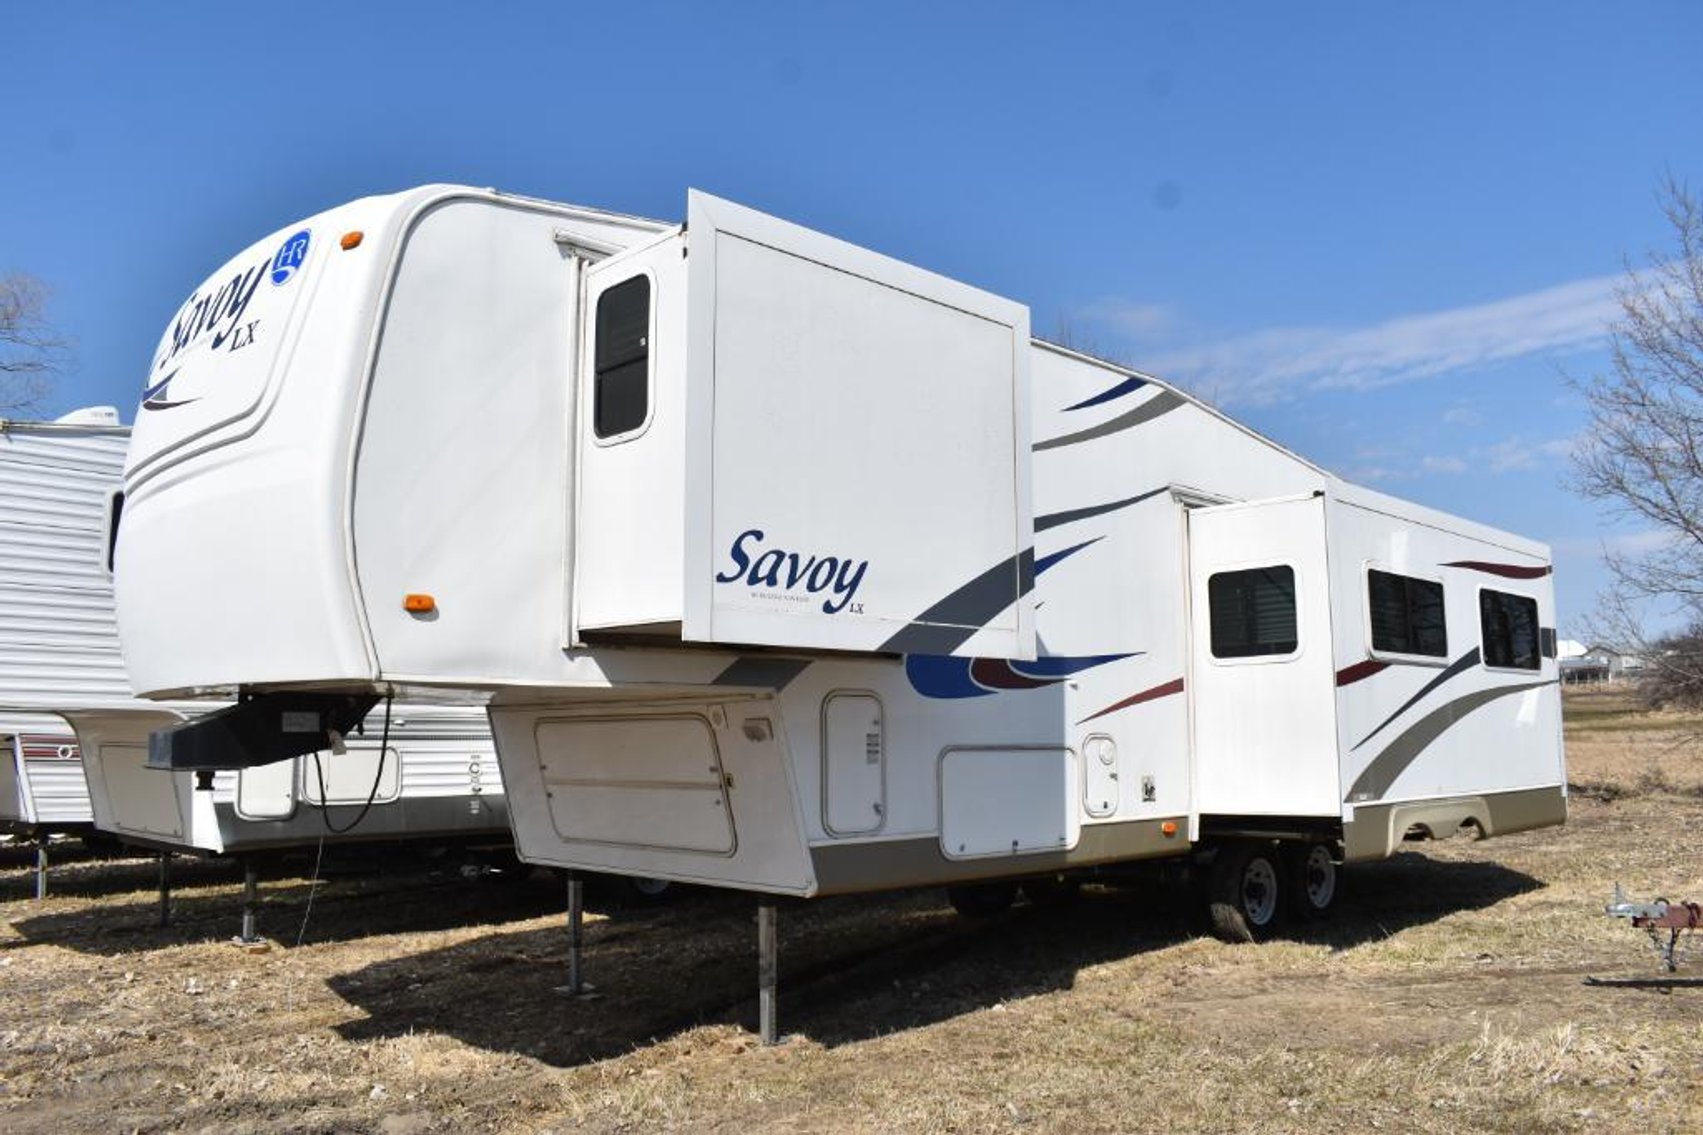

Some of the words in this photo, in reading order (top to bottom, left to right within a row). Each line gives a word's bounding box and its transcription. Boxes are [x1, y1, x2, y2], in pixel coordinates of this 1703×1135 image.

[278, 239, 307, 267] HR
[160, 257, 272, 370] Savoy
[229, 319, 261, 352] LX
[716, 529, 869, 615] Savoy
[849, 602, 865, 615] LX
